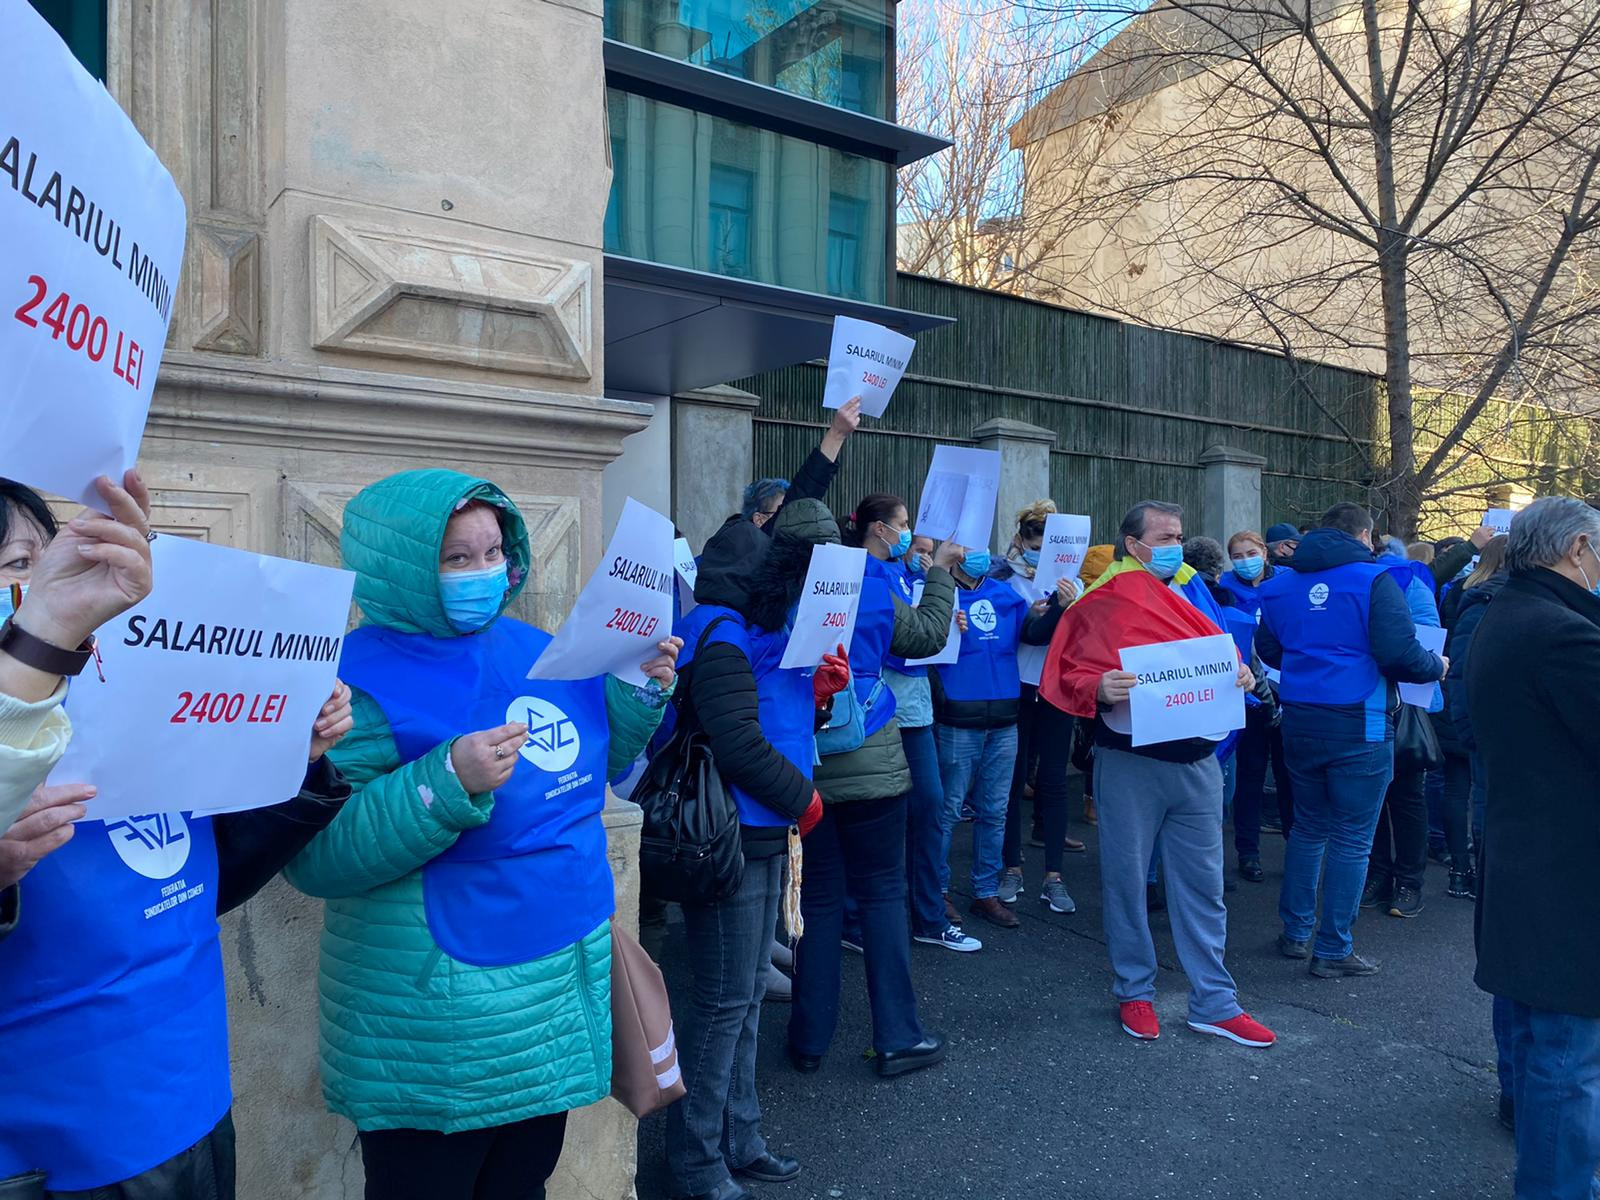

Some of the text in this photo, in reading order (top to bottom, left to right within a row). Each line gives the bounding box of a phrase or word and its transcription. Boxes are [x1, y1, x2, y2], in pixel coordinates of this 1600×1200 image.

[0, 136, 122, 271] ALARIUL
[15, 275, 144, 390] 2400 LEI
[846, 344, 884, 365] SALARIUL
[609, 556, 656, 590] SALARIUL
[813, 581, 849, 595] SALARIUL
[606, 608, 659, 637] 2400 LEI
[822, 612, 847, 627] 2400
[124, 615, 340, 662] SALARIUL MINIM
[1138, 661, 1232, 685] SALARIUL MINIM
[170, 691, 287, 723] 2400 LEI
[1165, 688, 1214, 708] 2400 LEI
